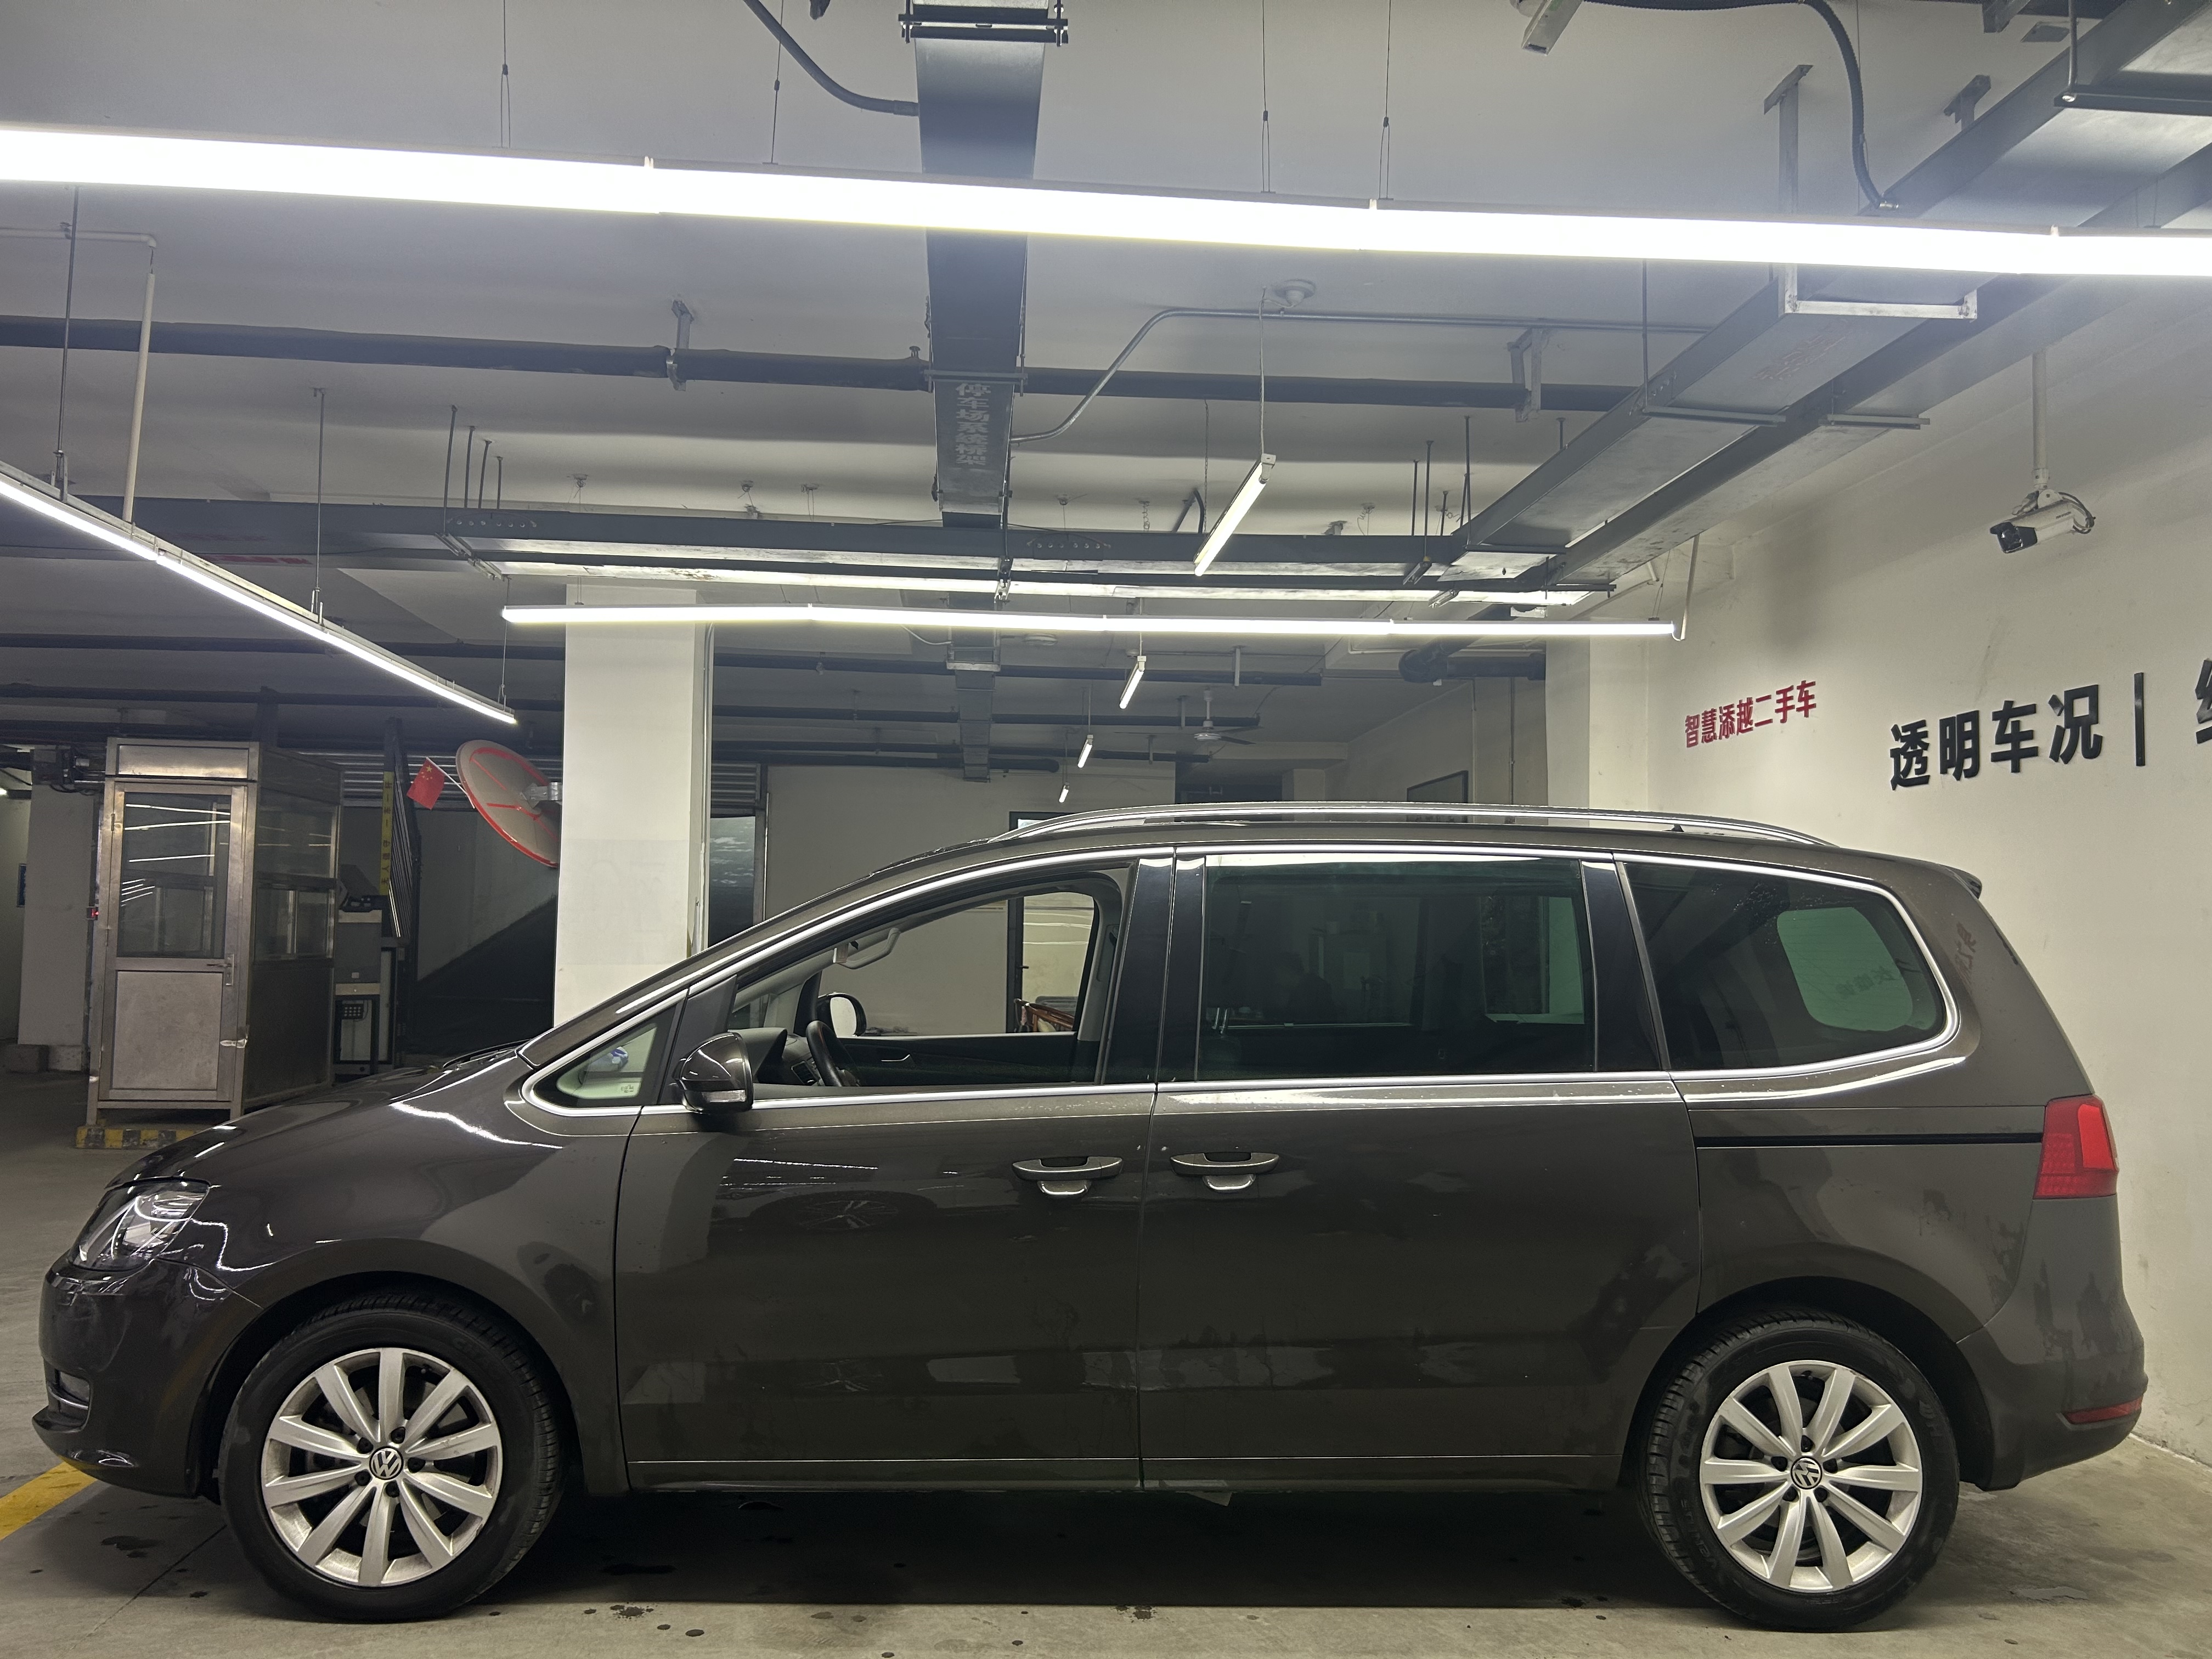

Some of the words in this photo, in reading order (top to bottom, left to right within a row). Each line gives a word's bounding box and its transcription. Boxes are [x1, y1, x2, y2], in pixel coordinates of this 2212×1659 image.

[955, 383, 991, 466] 停车场系统桥架
[1685, 680, 1816, 748] 智慧添越二手车
[1890, 684, 2103, 791] 透明车况
